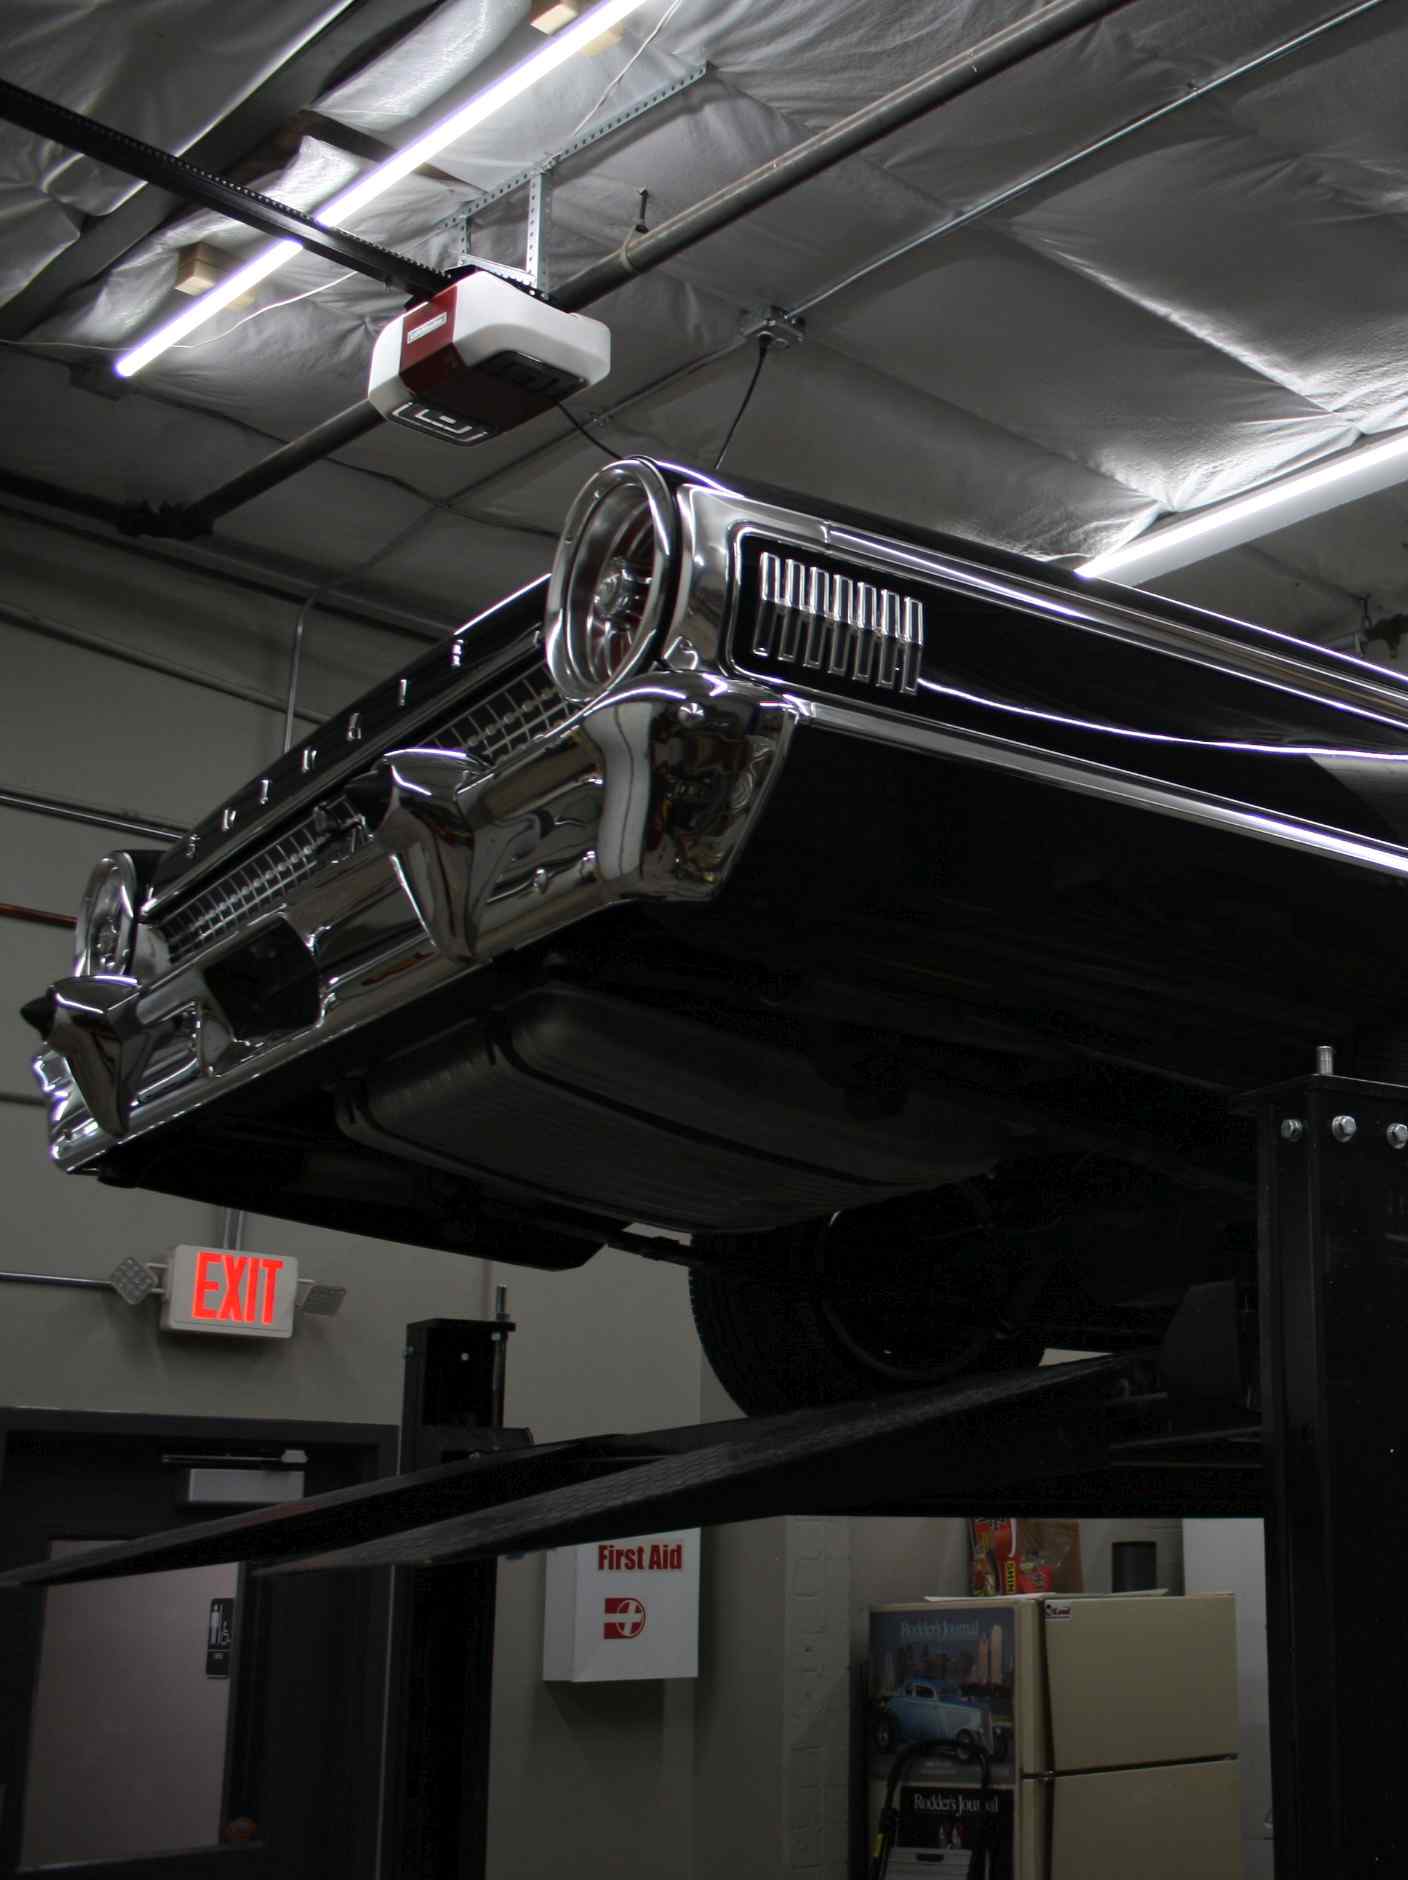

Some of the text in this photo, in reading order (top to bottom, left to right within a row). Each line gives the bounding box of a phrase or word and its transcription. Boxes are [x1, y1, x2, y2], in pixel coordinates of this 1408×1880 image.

[192, 1252, 285, 1325] EXIT
[597, 1544, 682, 1570] First Aid
